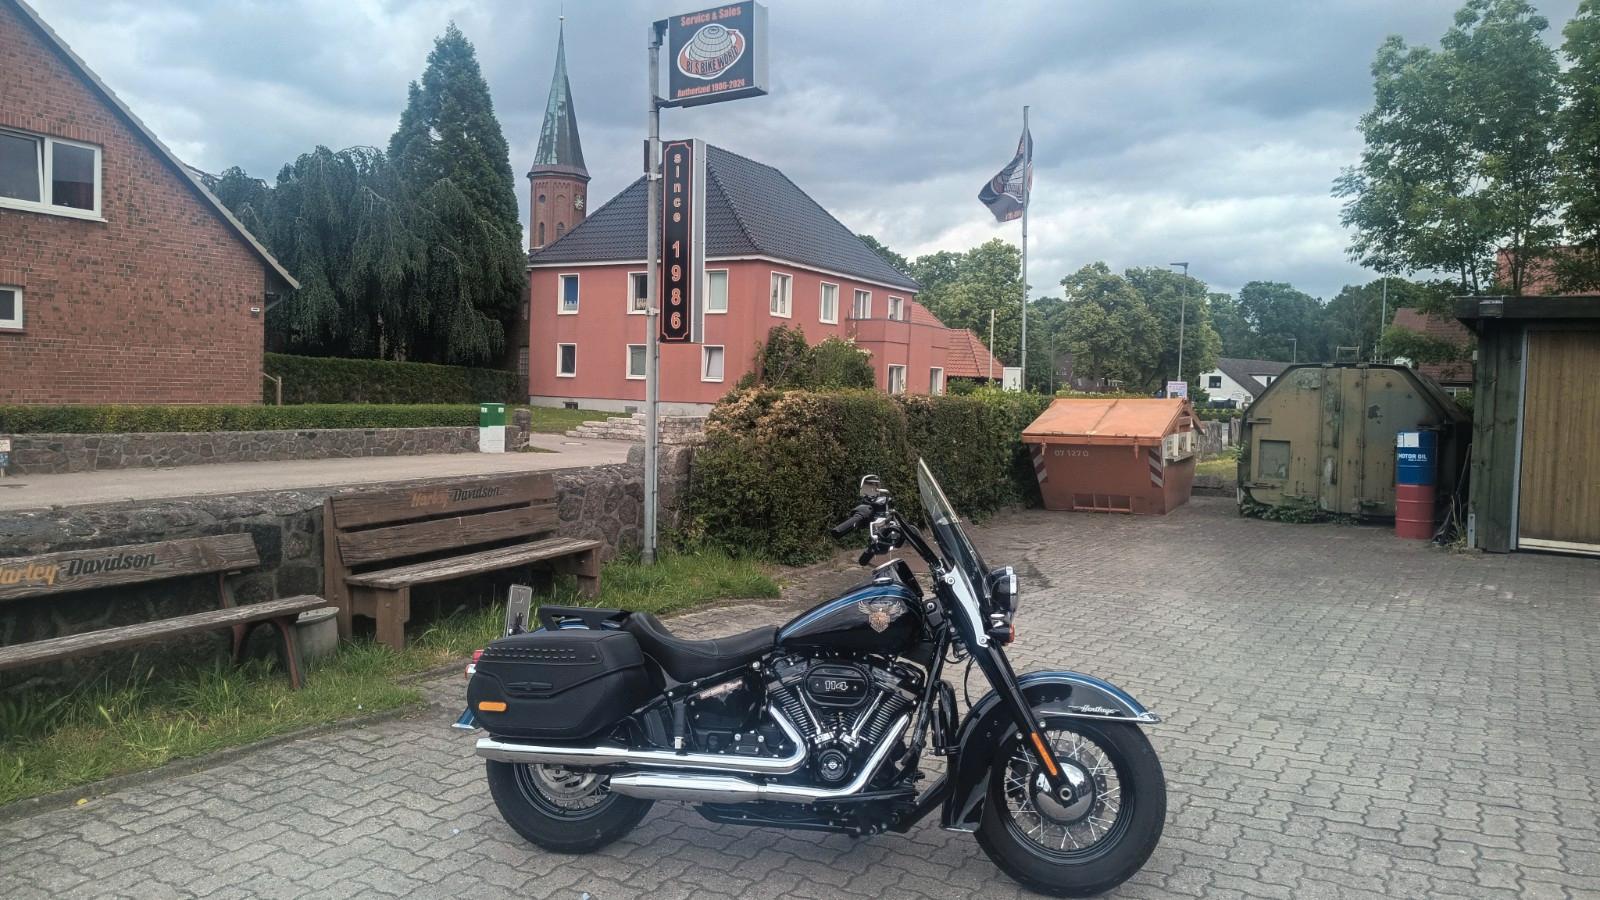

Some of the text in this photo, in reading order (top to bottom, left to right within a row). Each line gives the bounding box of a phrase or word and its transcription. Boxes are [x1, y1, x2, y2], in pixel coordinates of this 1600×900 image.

[680, 13, 710, 27] Service
[719, 6, 742, 19] Sales
[700, 59, 716, 73] BIKE
[670, 240, 682, 329] 1986
[825, 680, 849, 691] 114
